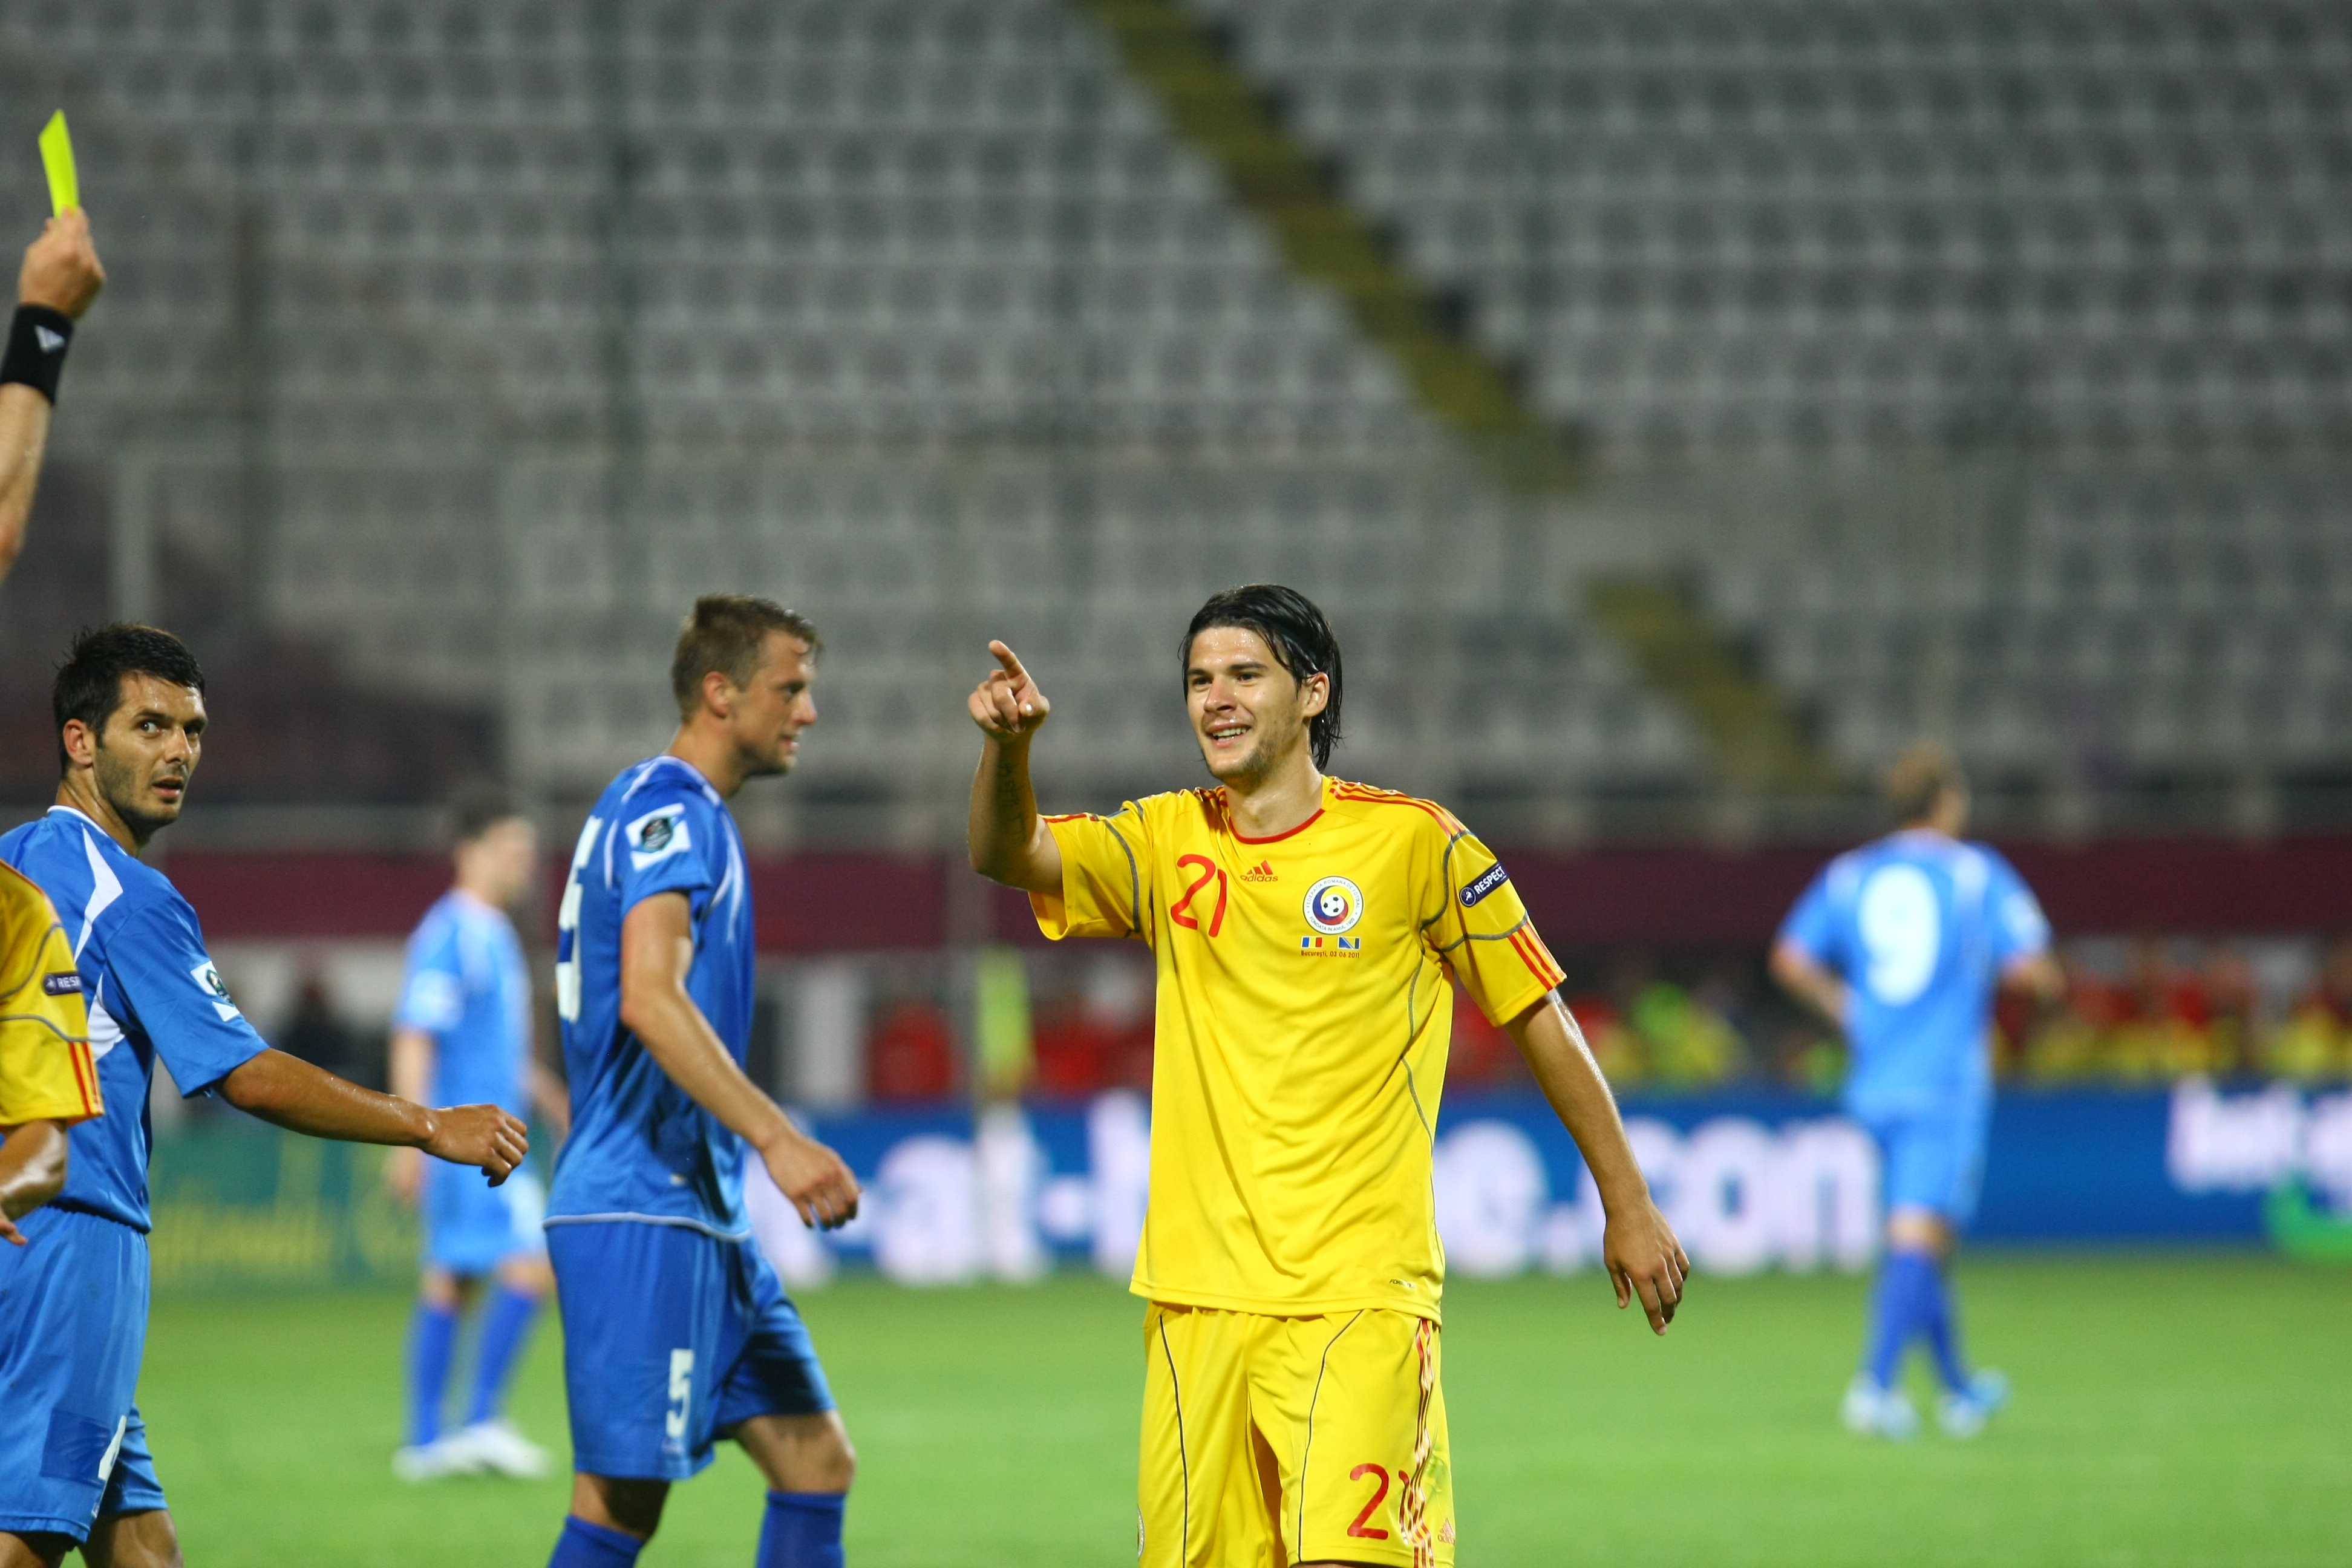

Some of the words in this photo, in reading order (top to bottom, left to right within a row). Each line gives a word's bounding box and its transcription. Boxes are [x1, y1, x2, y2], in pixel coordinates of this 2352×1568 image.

[1170, 854, 1227, 937] 21
[1240, 874, 1279, 882] adidas
[1474, 866, 1506, 894] RESPECT
[1857, 863, 1939, 1007] 9
[667, 1348, 695, 1438] 5
